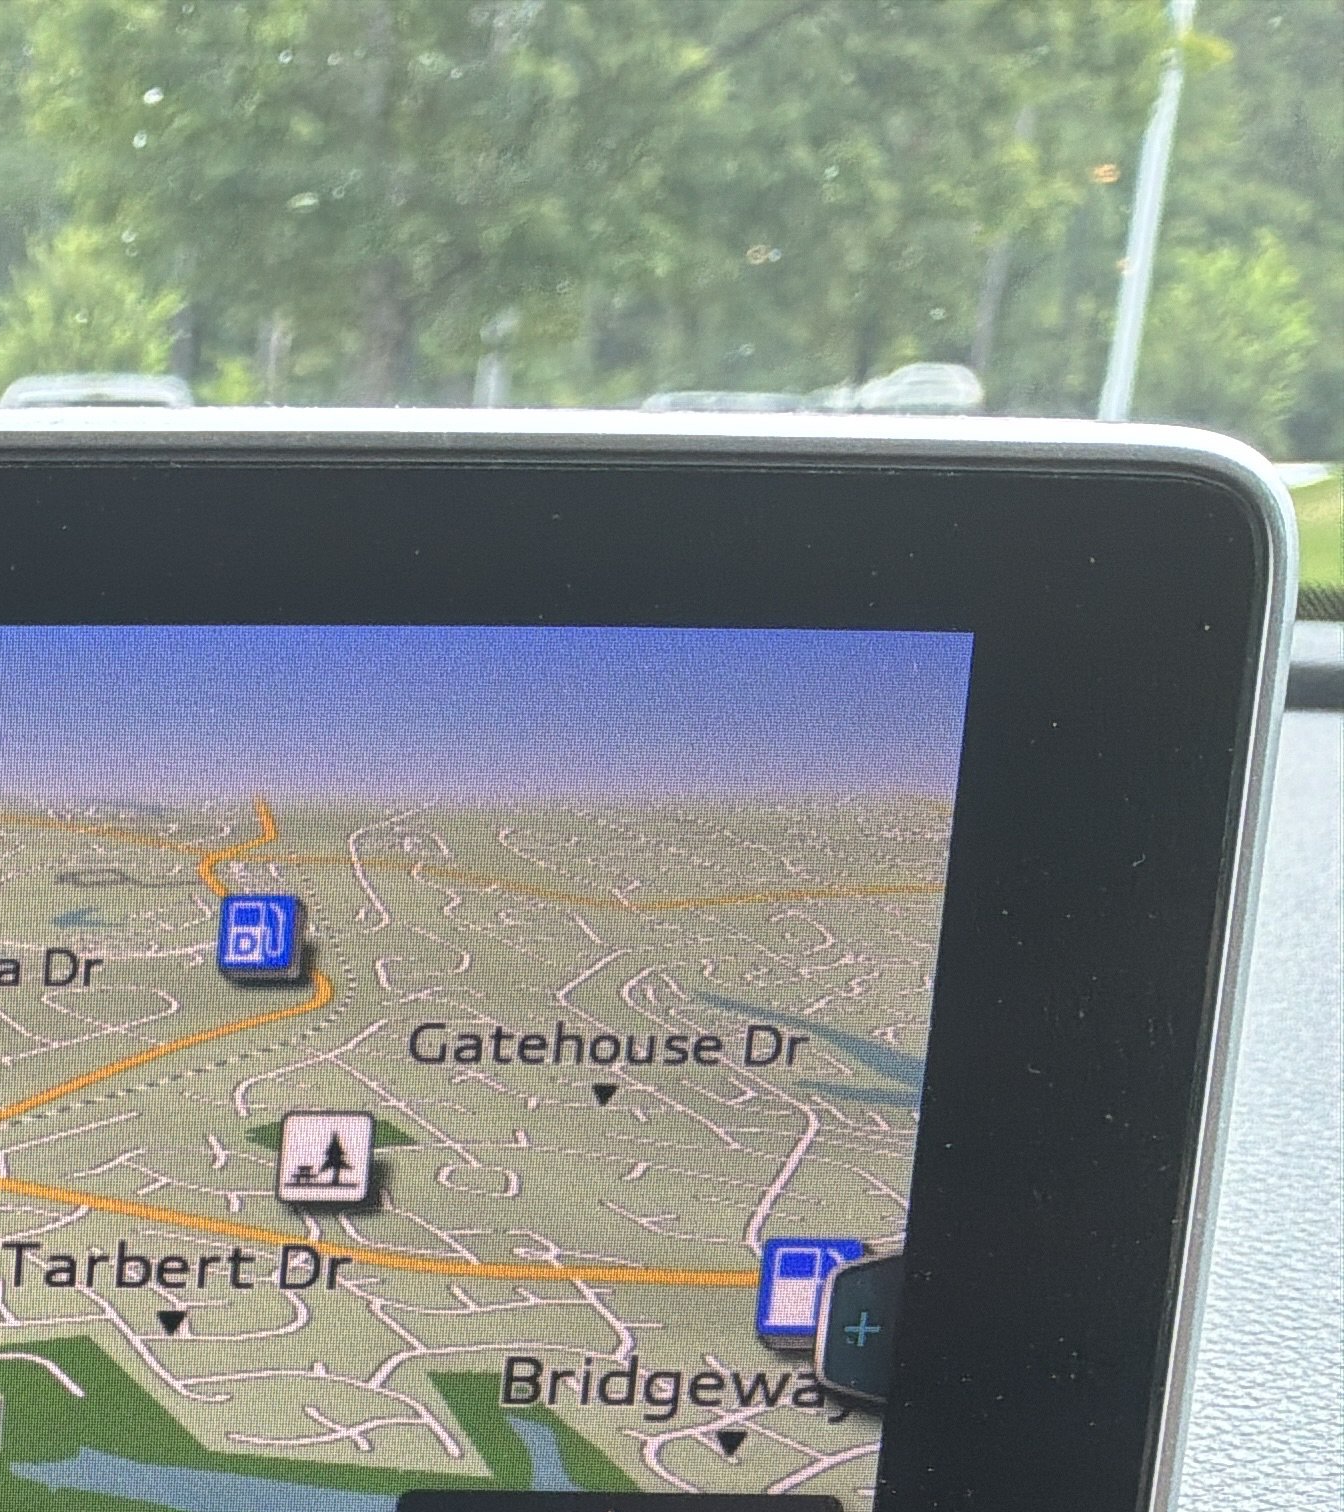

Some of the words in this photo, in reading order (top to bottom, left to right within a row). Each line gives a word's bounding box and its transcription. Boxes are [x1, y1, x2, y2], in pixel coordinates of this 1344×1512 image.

[44, 948, 104, 988] Dr
[409, 1020, 724, 1066] Gatehouse
[744, 1024, 810, 1067] Dr
[2, 1241, 255, 1289] Tarbert
[280, 1244, 352, 1290] Dr
